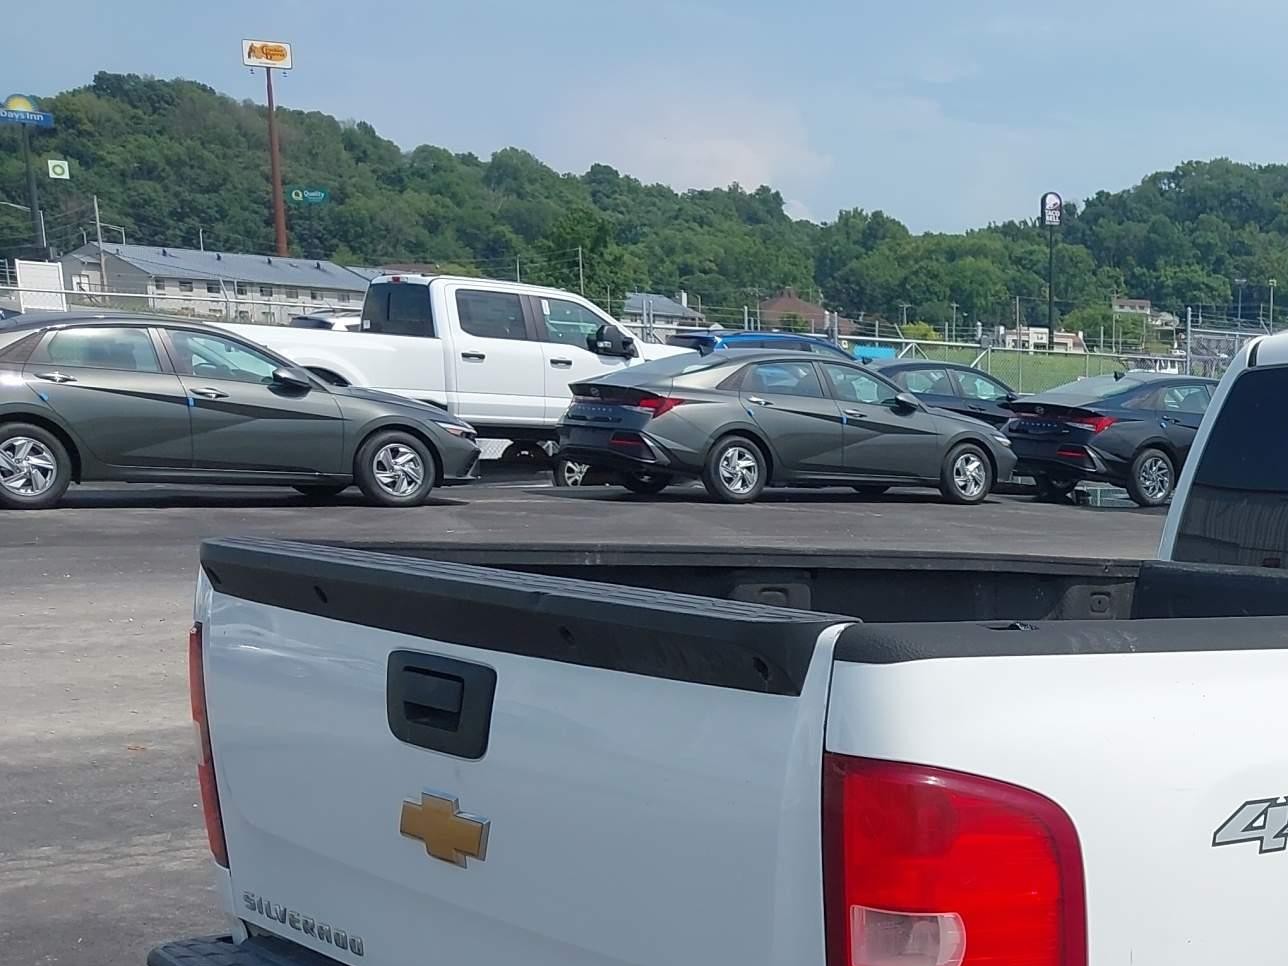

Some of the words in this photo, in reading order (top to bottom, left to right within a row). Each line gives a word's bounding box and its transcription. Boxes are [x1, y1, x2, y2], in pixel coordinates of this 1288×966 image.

[0, 111, 25, 121] Days
[27, 113, 44, 121] Inn
[242, 890, 364, 956] SILVERADO
